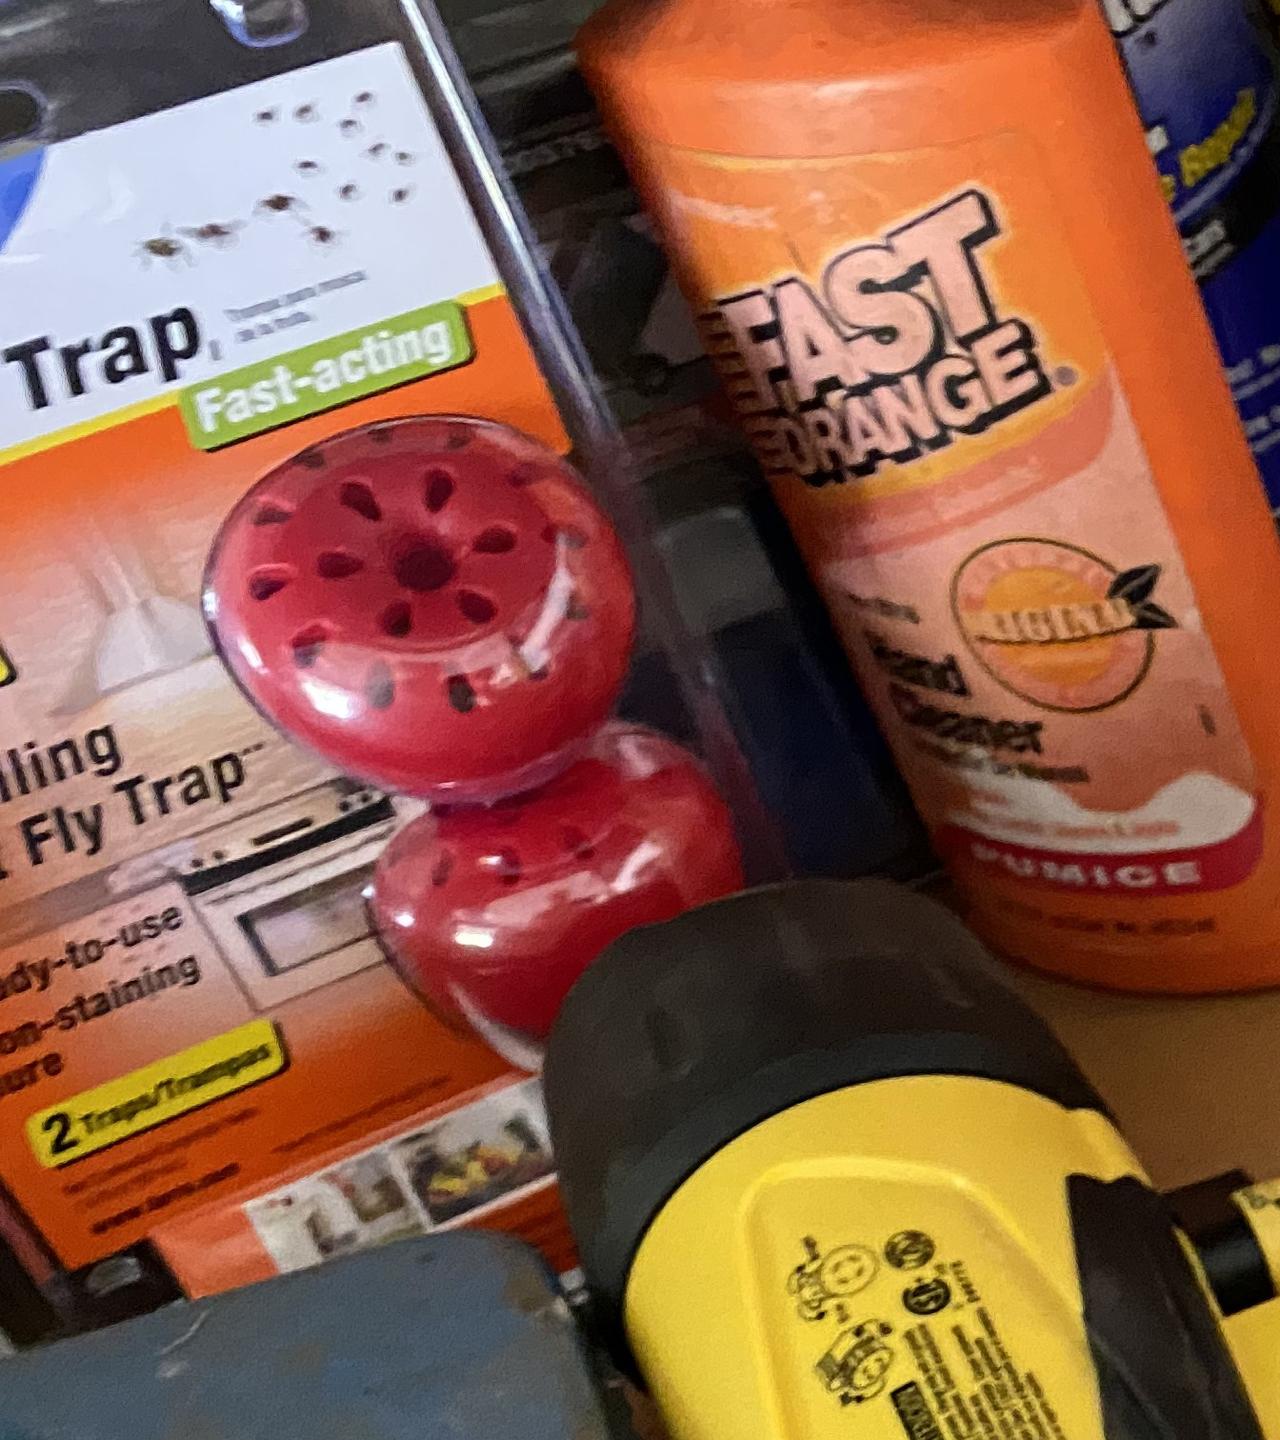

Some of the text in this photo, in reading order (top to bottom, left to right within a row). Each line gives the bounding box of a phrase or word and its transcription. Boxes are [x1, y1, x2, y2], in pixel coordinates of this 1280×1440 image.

[704, 187, 1000, 414] FAST
[2, 306, 200, 411] Trap
[193, 321, 450, 433] Fast-acting
[20, 752, 247, 867] Fly Trap
[42, 1112, 79, 1155] 2
